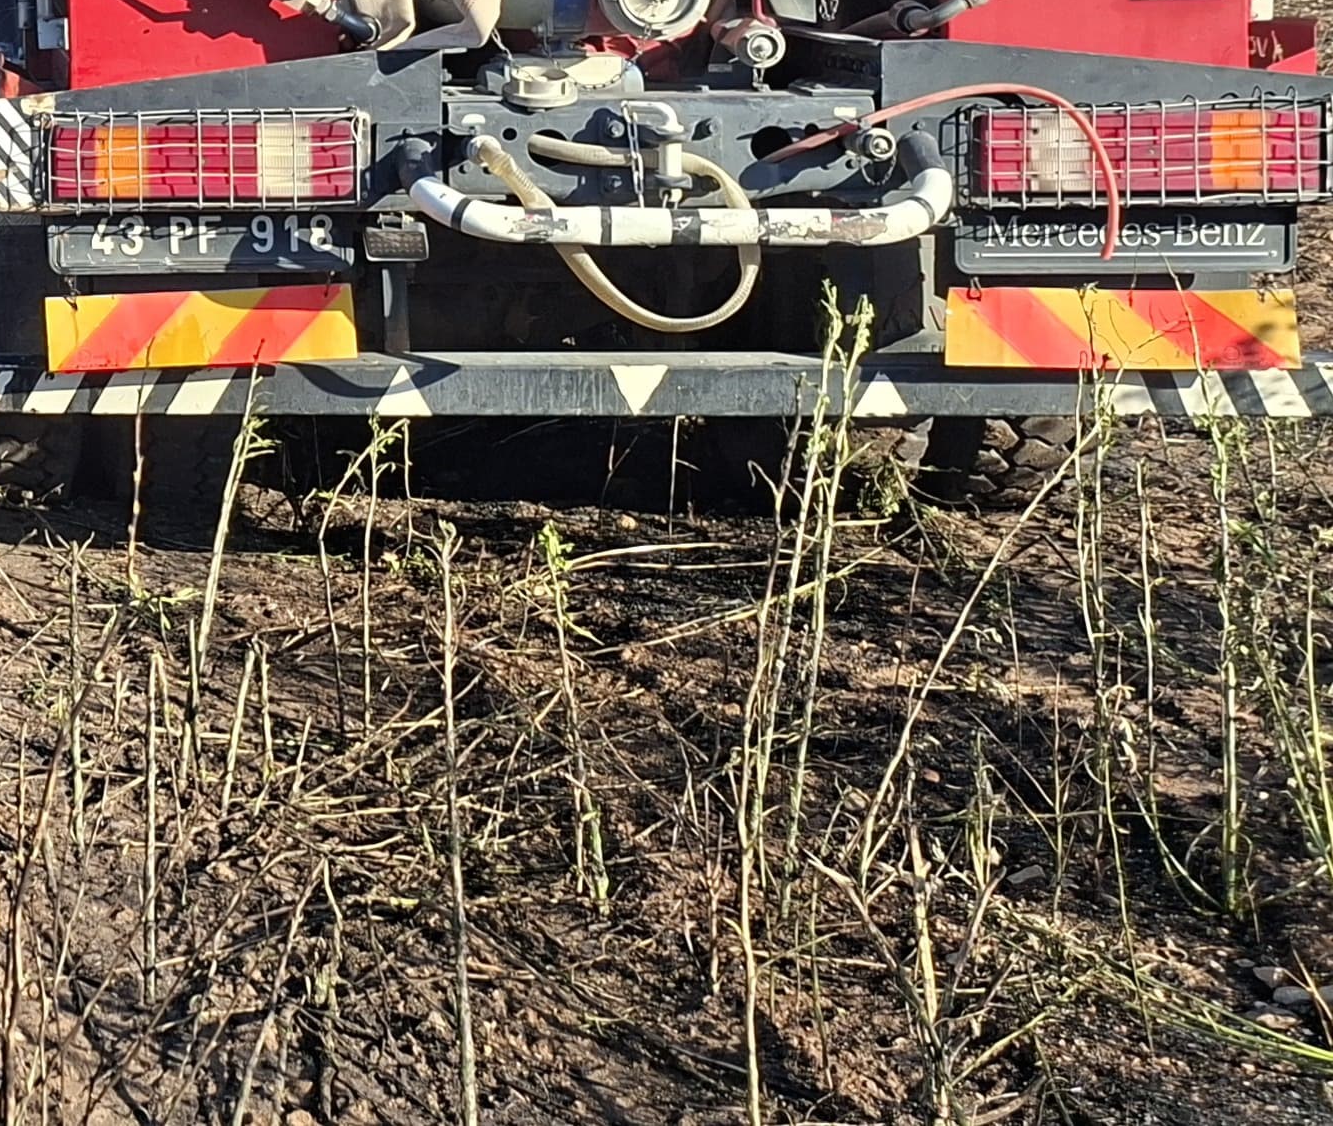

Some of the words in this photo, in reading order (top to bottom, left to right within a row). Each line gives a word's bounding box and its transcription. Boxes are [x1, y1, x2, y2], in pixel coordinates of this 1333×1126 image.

[91, 215, 144, 256] 43
[169, 215, 221, 255] PF
[251, 215, 333, 254] 918
